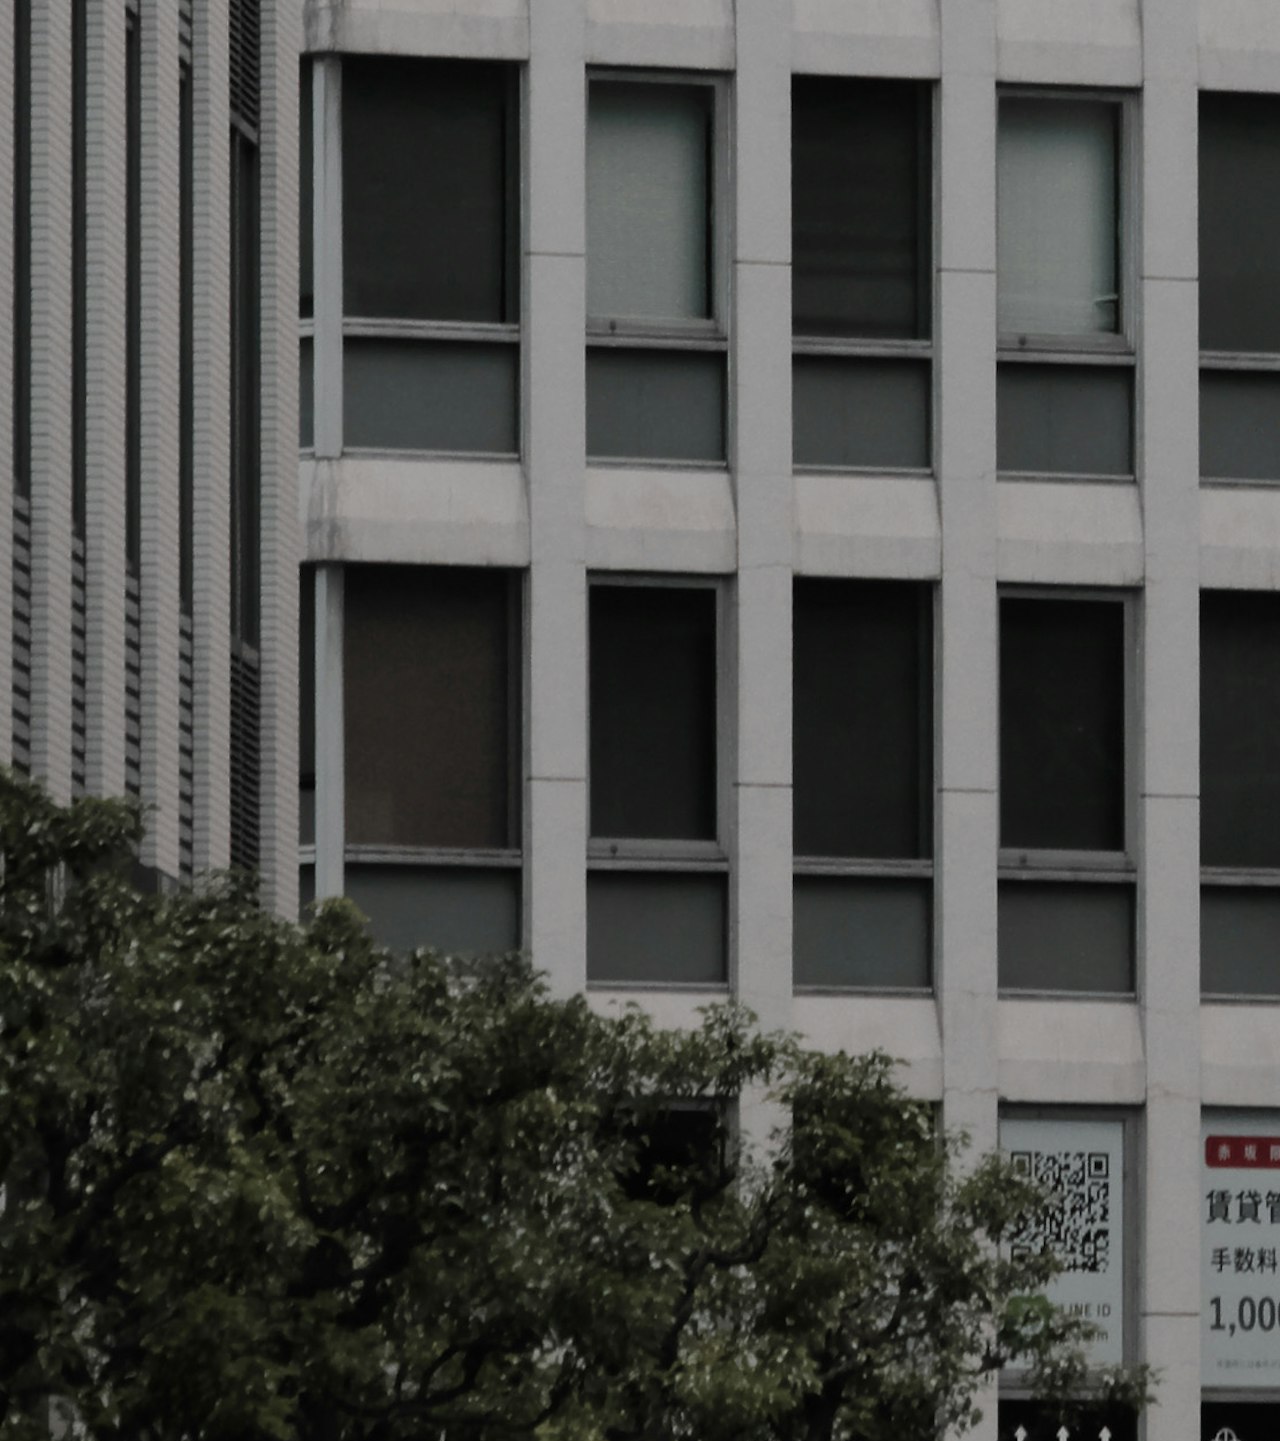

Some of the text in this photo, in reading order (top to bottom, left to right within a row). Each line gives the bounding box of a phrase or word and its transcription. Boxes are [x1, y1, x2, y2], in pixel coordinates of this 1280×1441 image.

[1210, 1246, 1278, 1275] 手数料
[1096, 1303, 1112, 1319] ID
